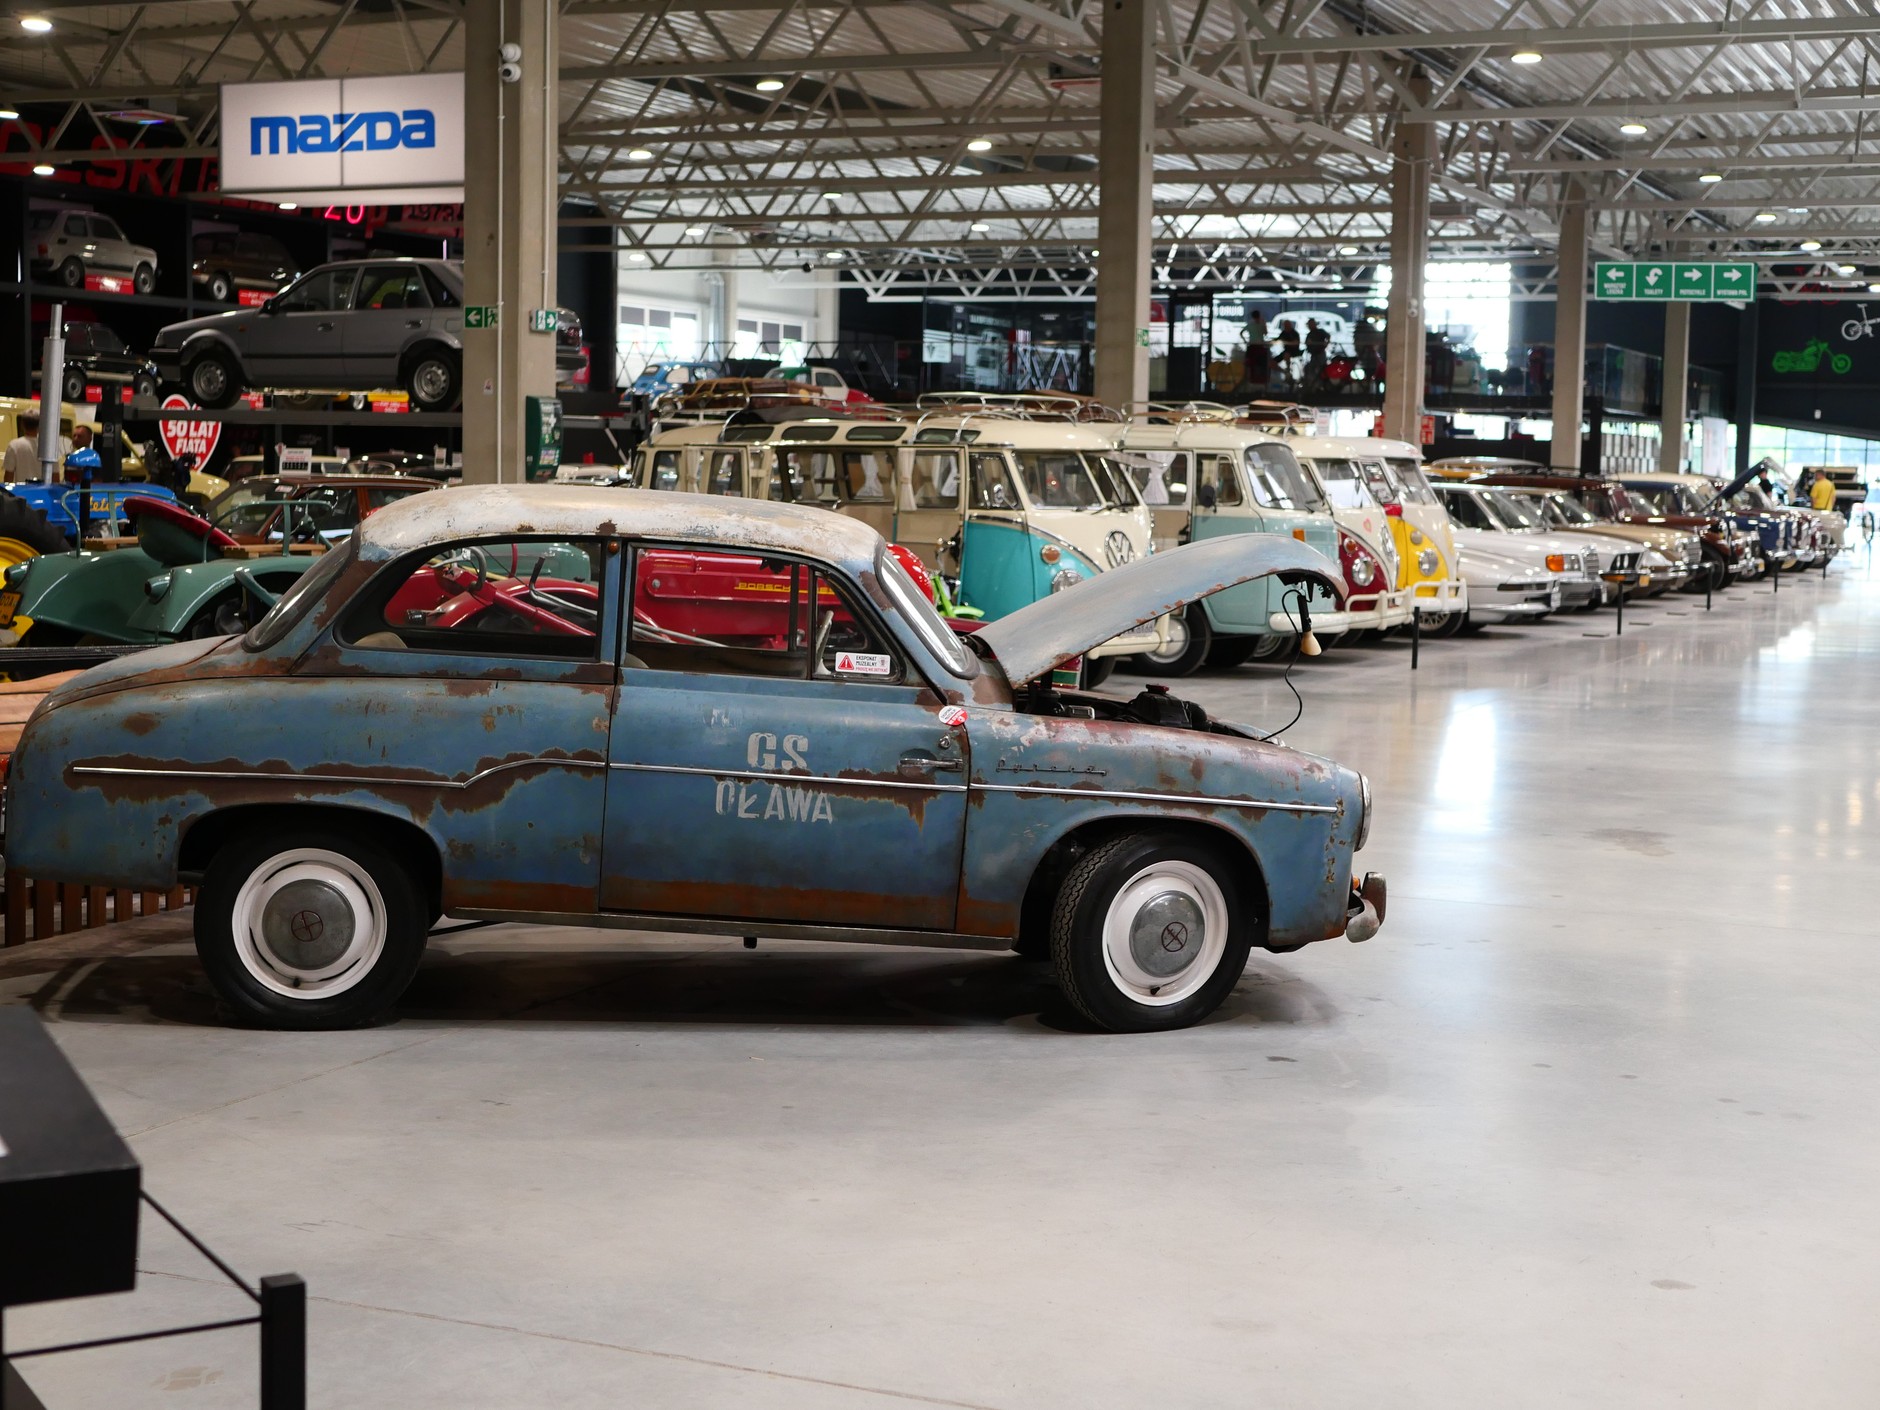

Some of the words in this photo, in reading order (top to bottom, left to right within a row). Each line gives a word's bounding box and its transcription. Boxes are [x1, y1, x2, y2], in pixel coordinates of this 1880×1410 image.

[166, 420, 188, 438] 50
[189, 421, 217, 438] LAT
[175, 438, 207, 454] FIATA
[738, 582, 791, 591] PORSCH
[747, 732, 808, 770] GS
[716, 778, 833, 824] OŁAWA
